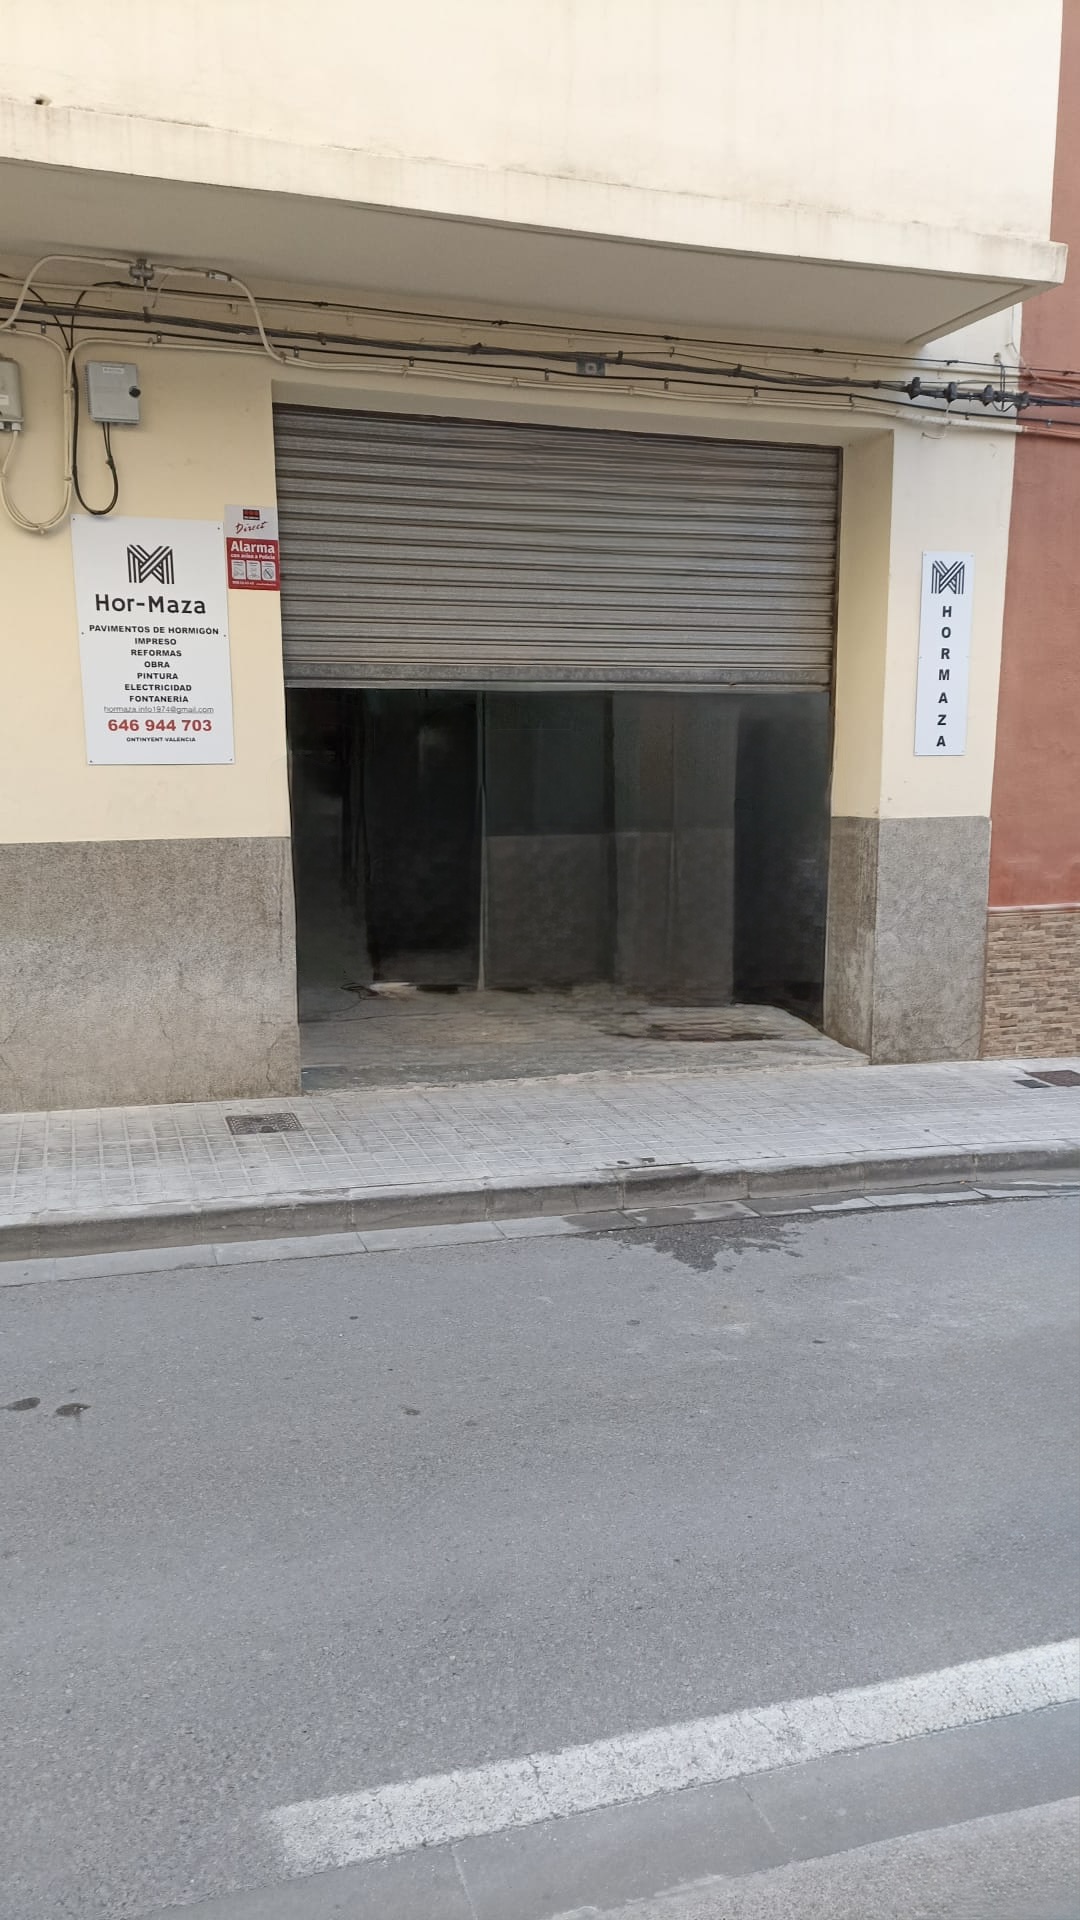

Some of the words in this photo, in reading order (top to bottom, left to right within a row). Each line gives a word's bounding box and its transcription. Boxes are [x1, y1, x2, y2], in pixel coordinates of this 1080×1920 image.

[230, 540, 275, 554] Alarma
[95, 593, 206, 614] Hor-Maza
[89, 624, 150, 634] PAVIMENTOS
[153, 626, 165, 634] DE
[134, 637, 177, 646] IMPRESO
[130, 648, 182, 657] REFORMAS
[137, 672, 178, 680] PINTURA
[936, 605, 952, 747] HORMAZA
[124, 683, 192, 691] ELECTRICIDAD
[107, 719, 139, 731] 646
[145, 719, 176, 731] 944
[181, 719, 212, 731] 703
